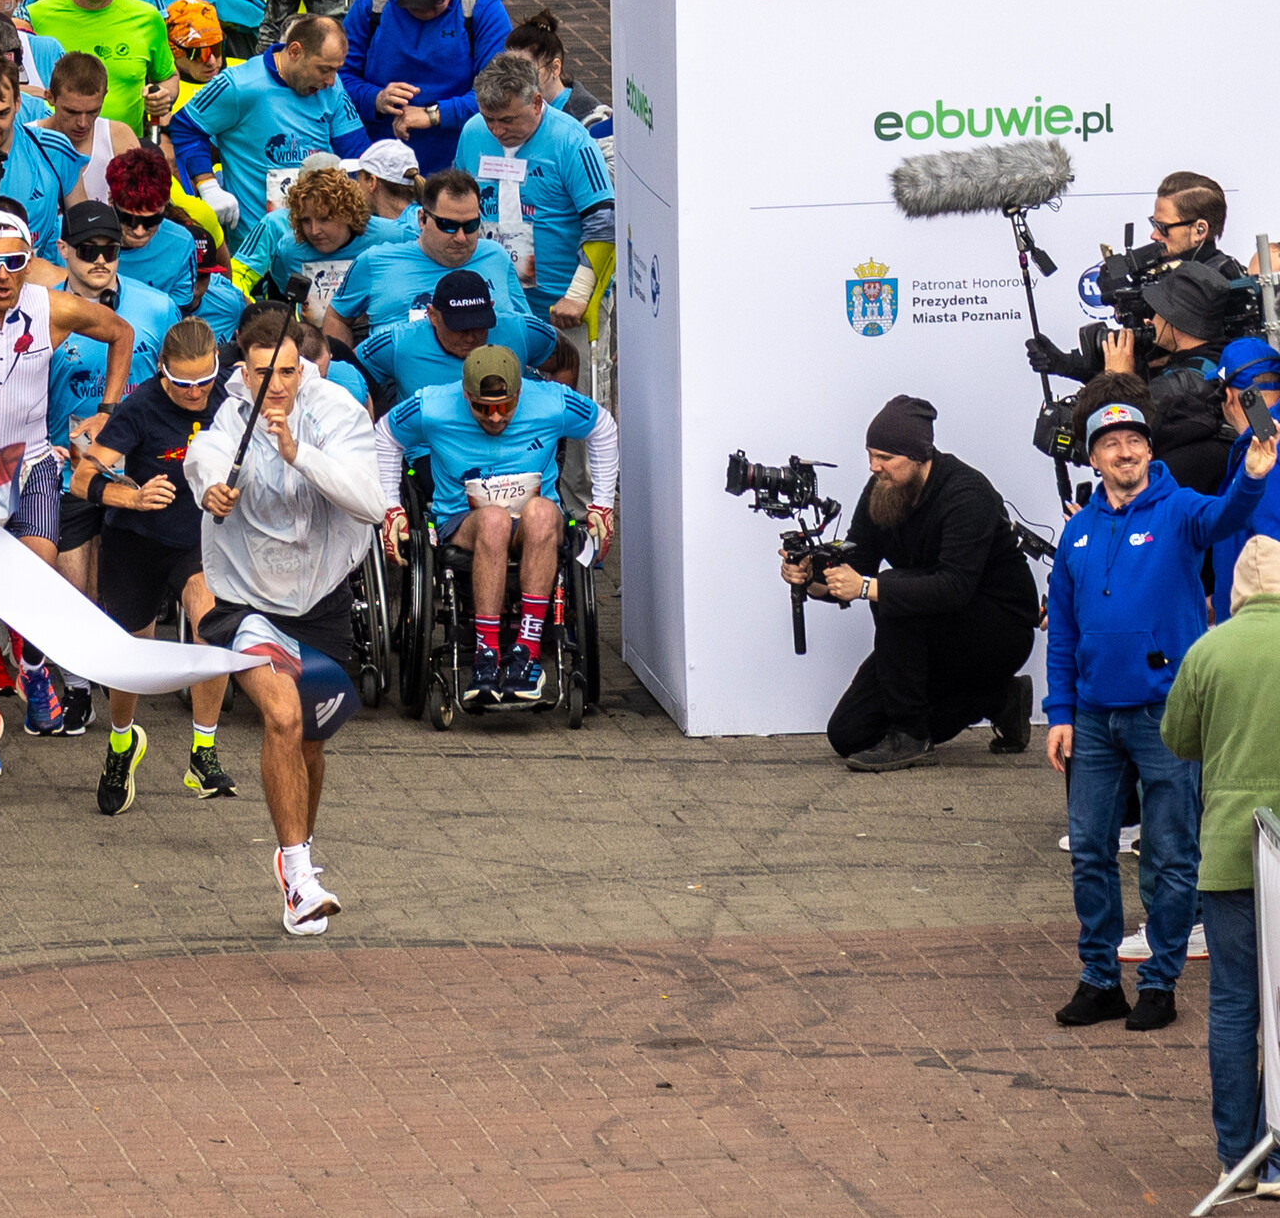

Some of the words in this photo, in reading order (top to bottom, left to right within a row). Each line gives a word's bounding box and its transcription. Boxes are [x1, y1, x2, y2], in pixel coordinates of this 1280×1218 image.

[874, 95, 1114, 142] eobuwie.pl
[912, 278, 968, 291] Patronat
[449, 297, 486, 307] GARMIN
[912, 294, 988, 309] Prezydenta
[912, 312, 957, 324] Miasta
[962, 309, 1022, 323] Poznania
[485, 485, 526, 501] 17725
